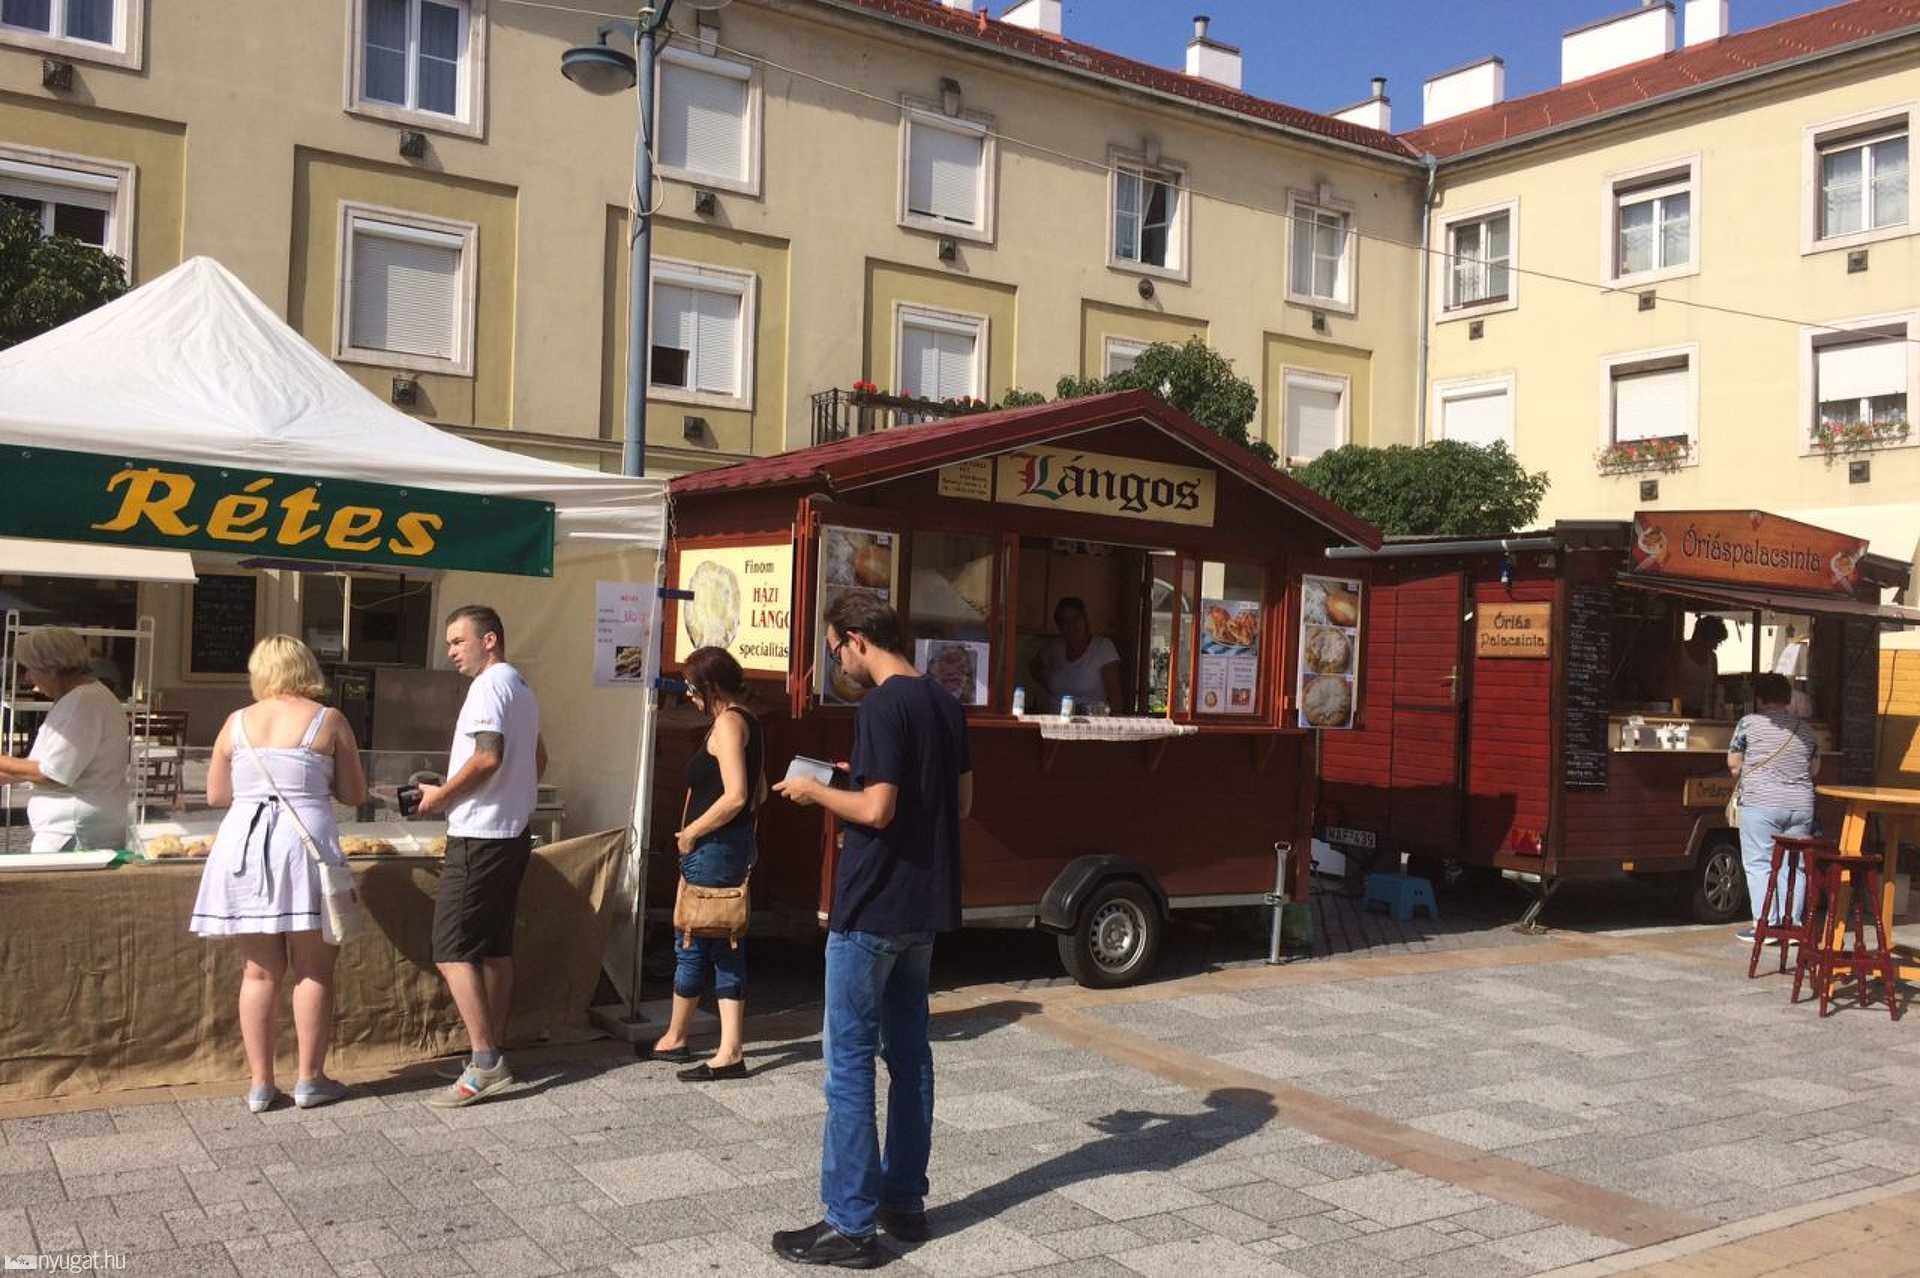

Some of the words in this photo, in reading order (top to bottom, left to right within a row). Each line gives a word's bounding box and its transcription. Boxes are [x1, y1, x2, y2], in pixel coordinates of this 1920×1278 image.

[1010, 453, 1201, 513] Lángos
[91, 467, 444, 556] Rétes
[1681, 523, 1821, 573] Óriáspalacsinta
[744, 559, 775, 575] Finom
[753, 581, 779, 603] HÁZI
[1494, 611, 1532, 630] Óriás
[1480, 632, 1545, 649] Palacsinta
